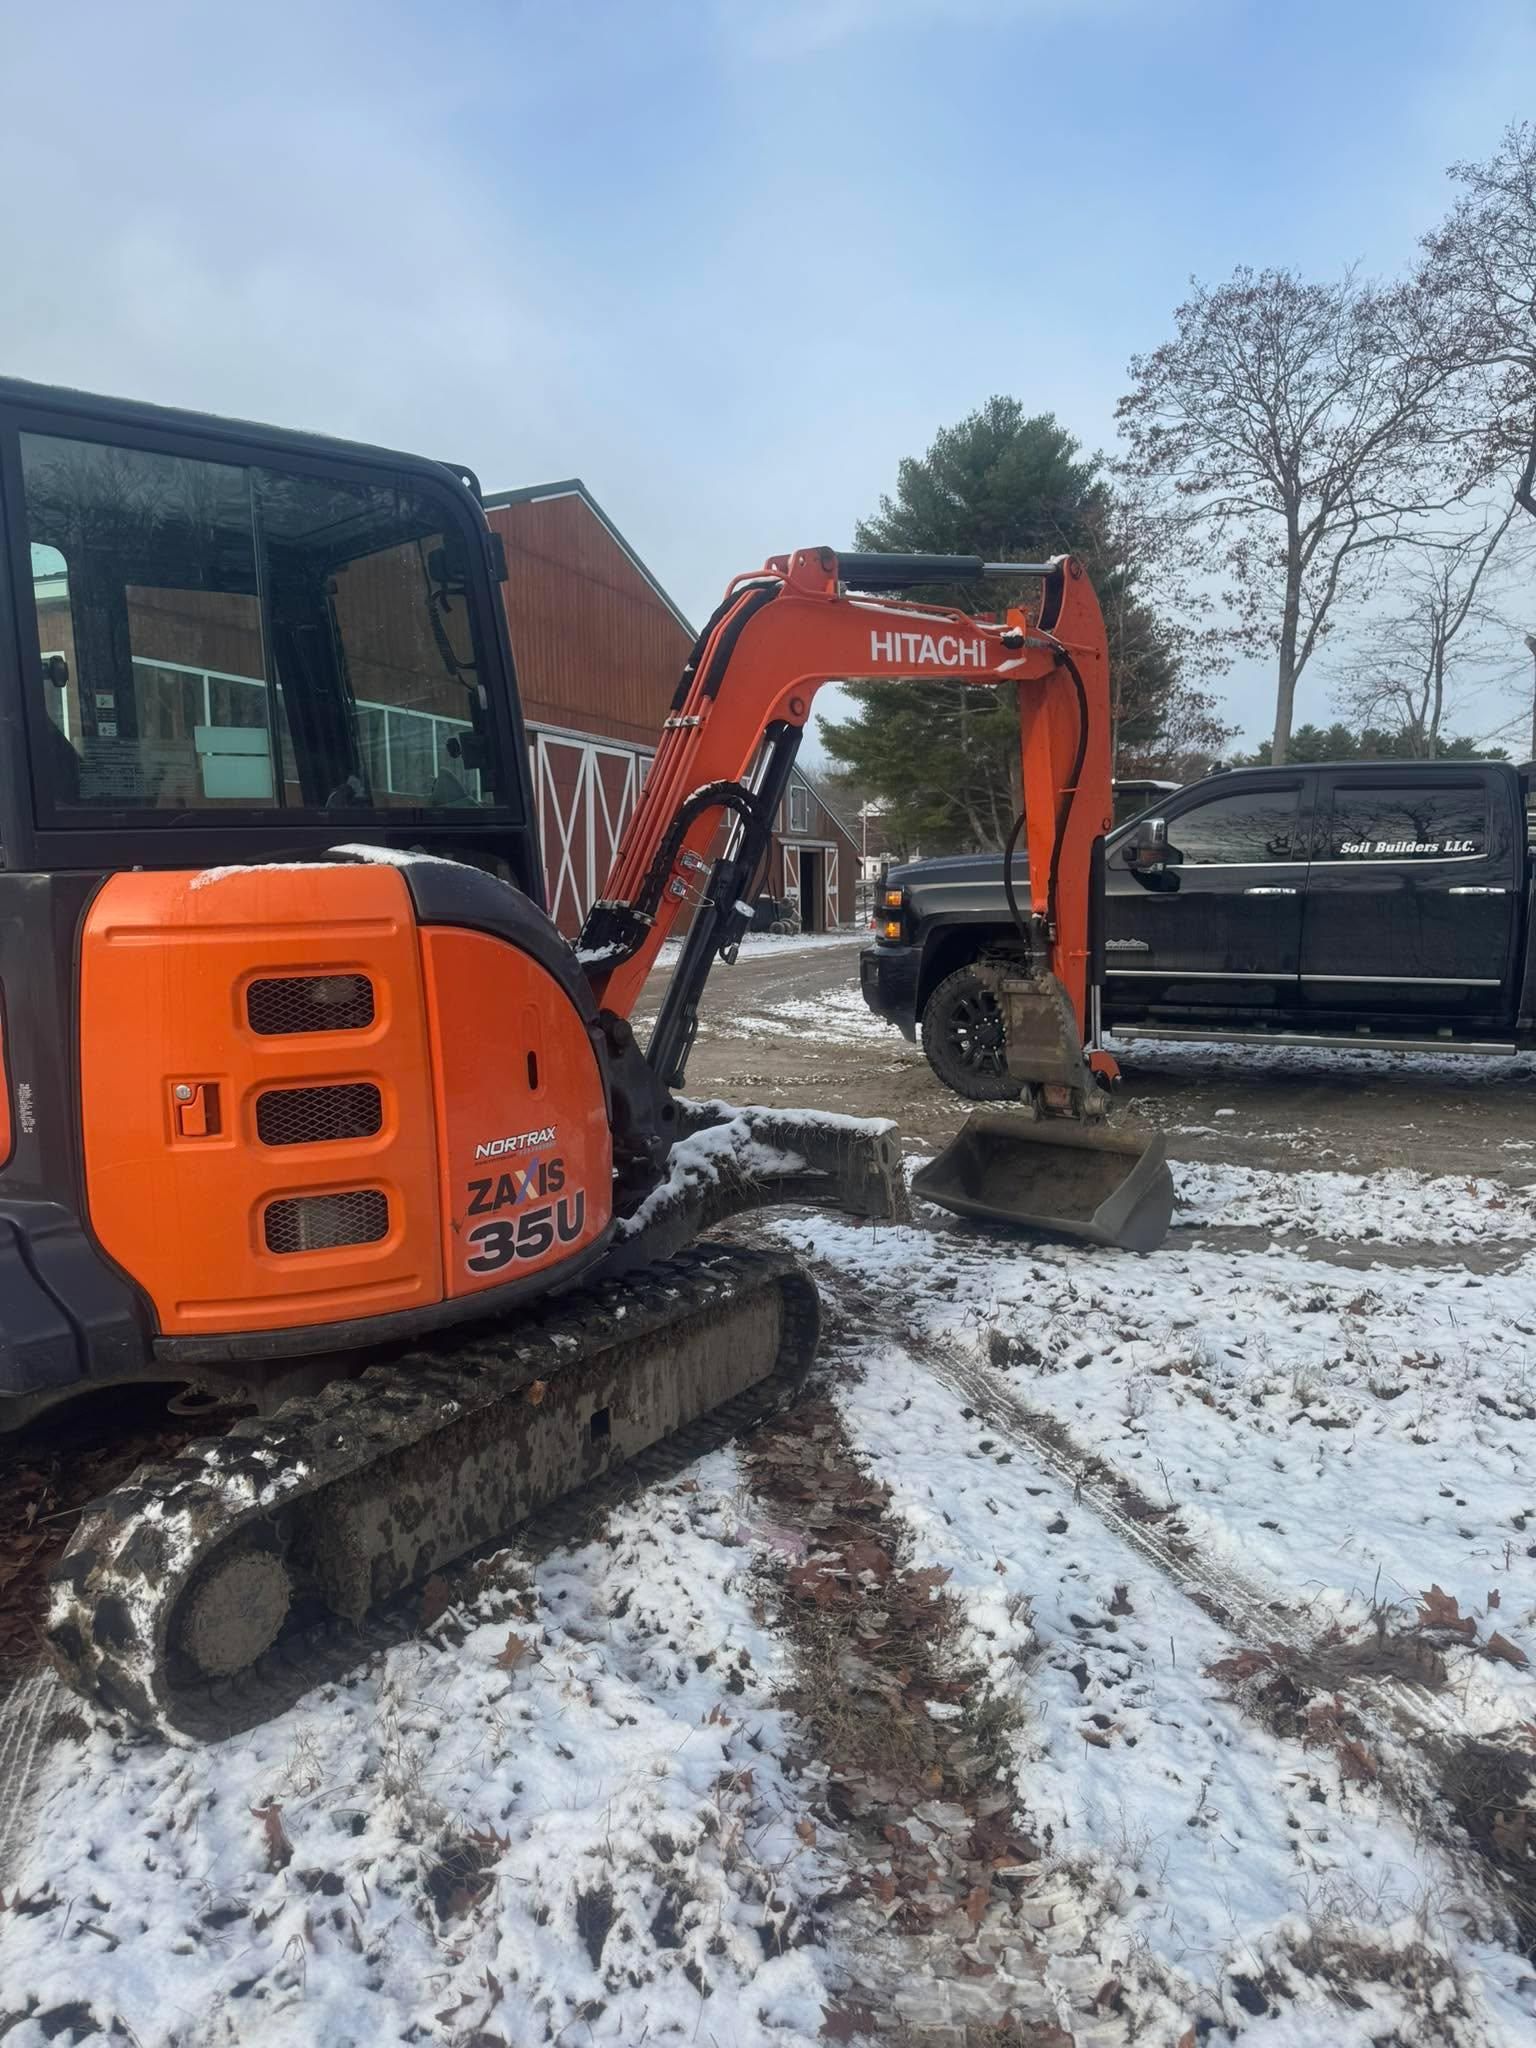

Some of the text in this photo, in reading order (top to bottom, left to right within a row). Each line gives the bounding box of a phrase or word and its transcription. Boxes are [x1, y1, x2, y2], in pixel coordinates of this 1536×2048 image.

[870, 630, 987, 667] HITACHI
[1340, 840, 1475, 853] Soil Builders LLC.
[475, 1125, 557, 1160] NORTRAX
[467, 1157, 565, 1216] ZAXIS
[466, 1188, 585, 1273] 35U
